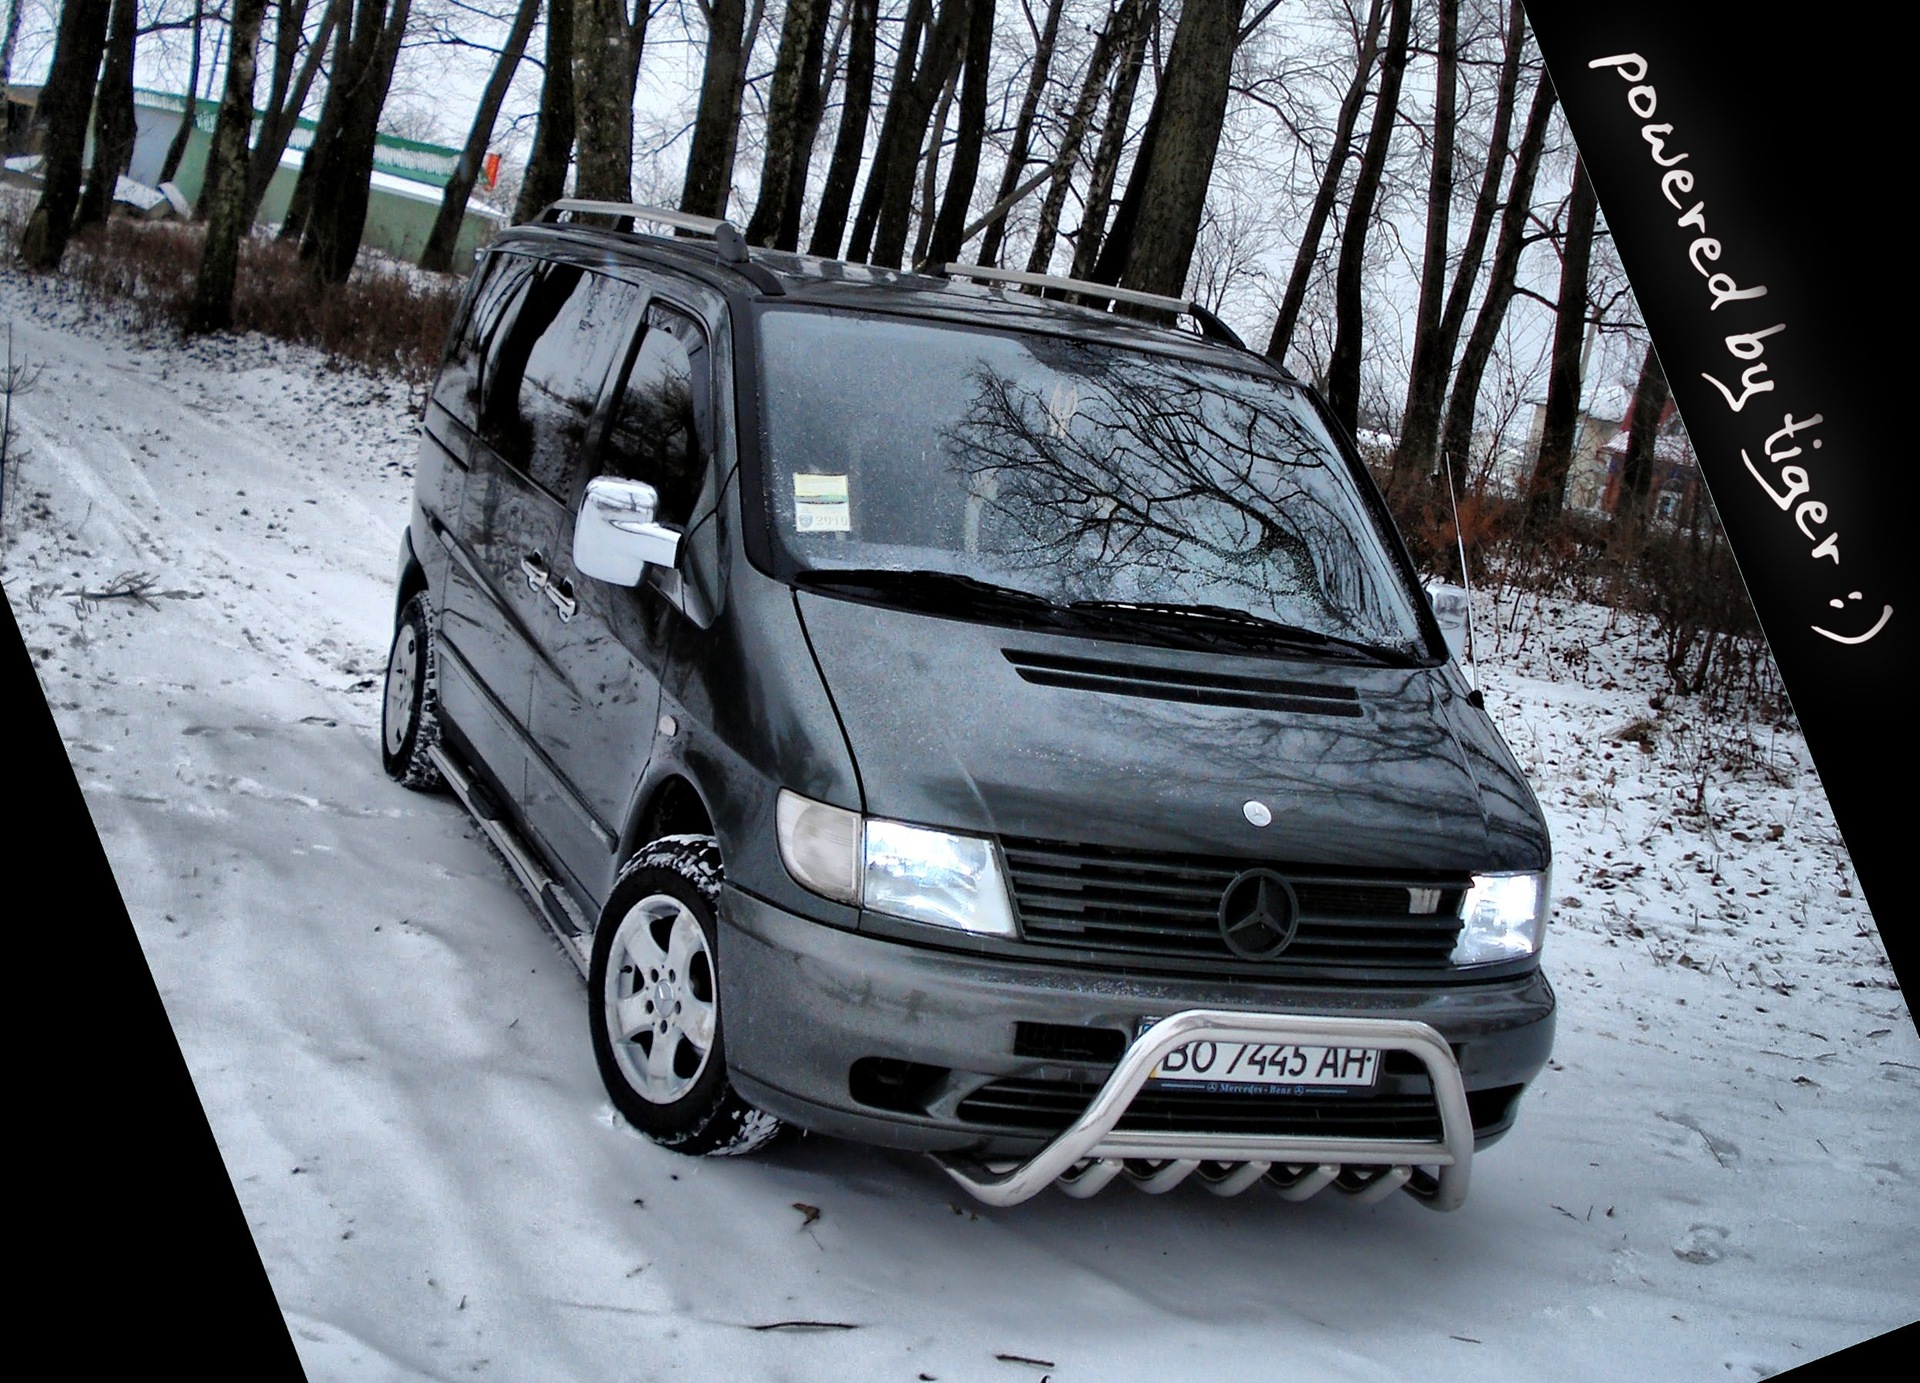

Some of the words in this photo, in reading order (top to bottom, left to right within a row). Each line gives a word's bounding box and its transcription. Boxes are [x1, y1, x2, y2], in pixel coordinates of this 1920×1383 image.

[1162, 1042, 1217, 1073] BO
[1226, 1044, 1307, 1076] 7445
[1315, 1047, 1367, 1078] AH
